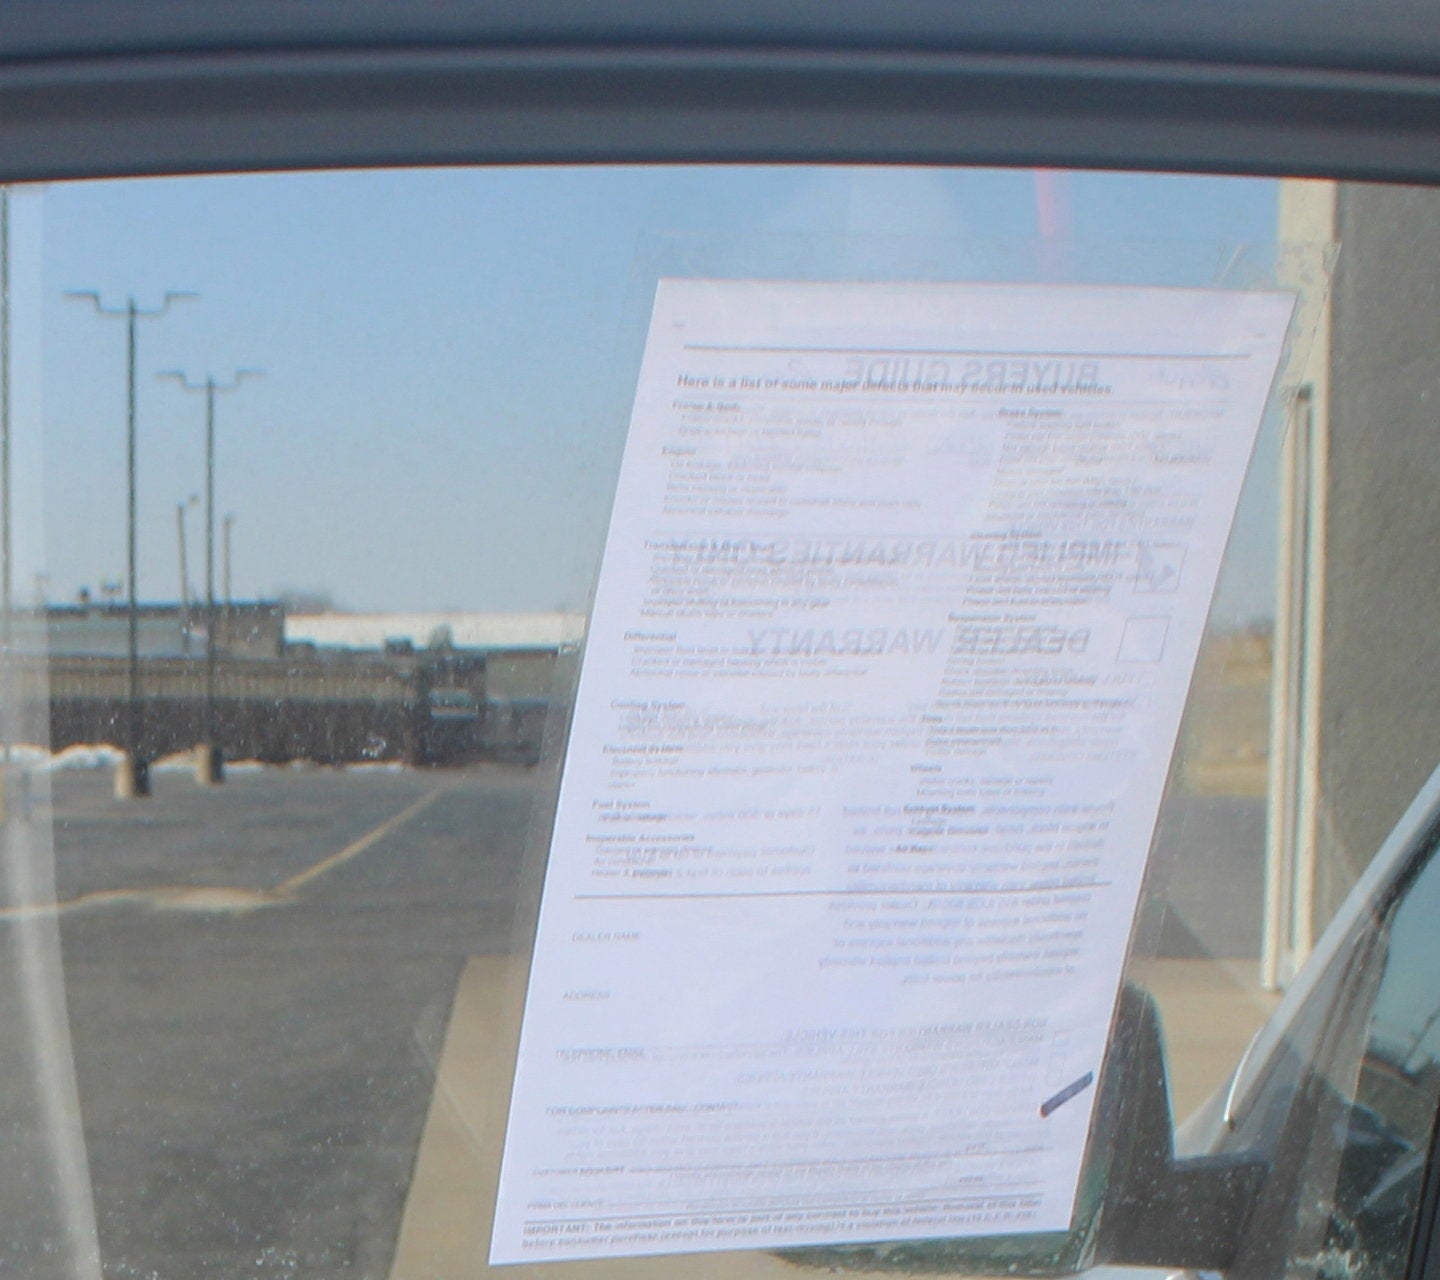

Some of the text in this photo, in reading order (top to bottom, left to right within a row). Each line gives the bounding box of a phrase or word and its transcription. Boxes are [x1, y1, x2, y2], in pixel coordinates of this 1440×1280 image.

[677, 375, 709, 387] Here
[740, 377, 761, 389] list
[764, 378, 779, 389] of
[782, 381, 817, 391] some
[820, 380, 860, 393] major
